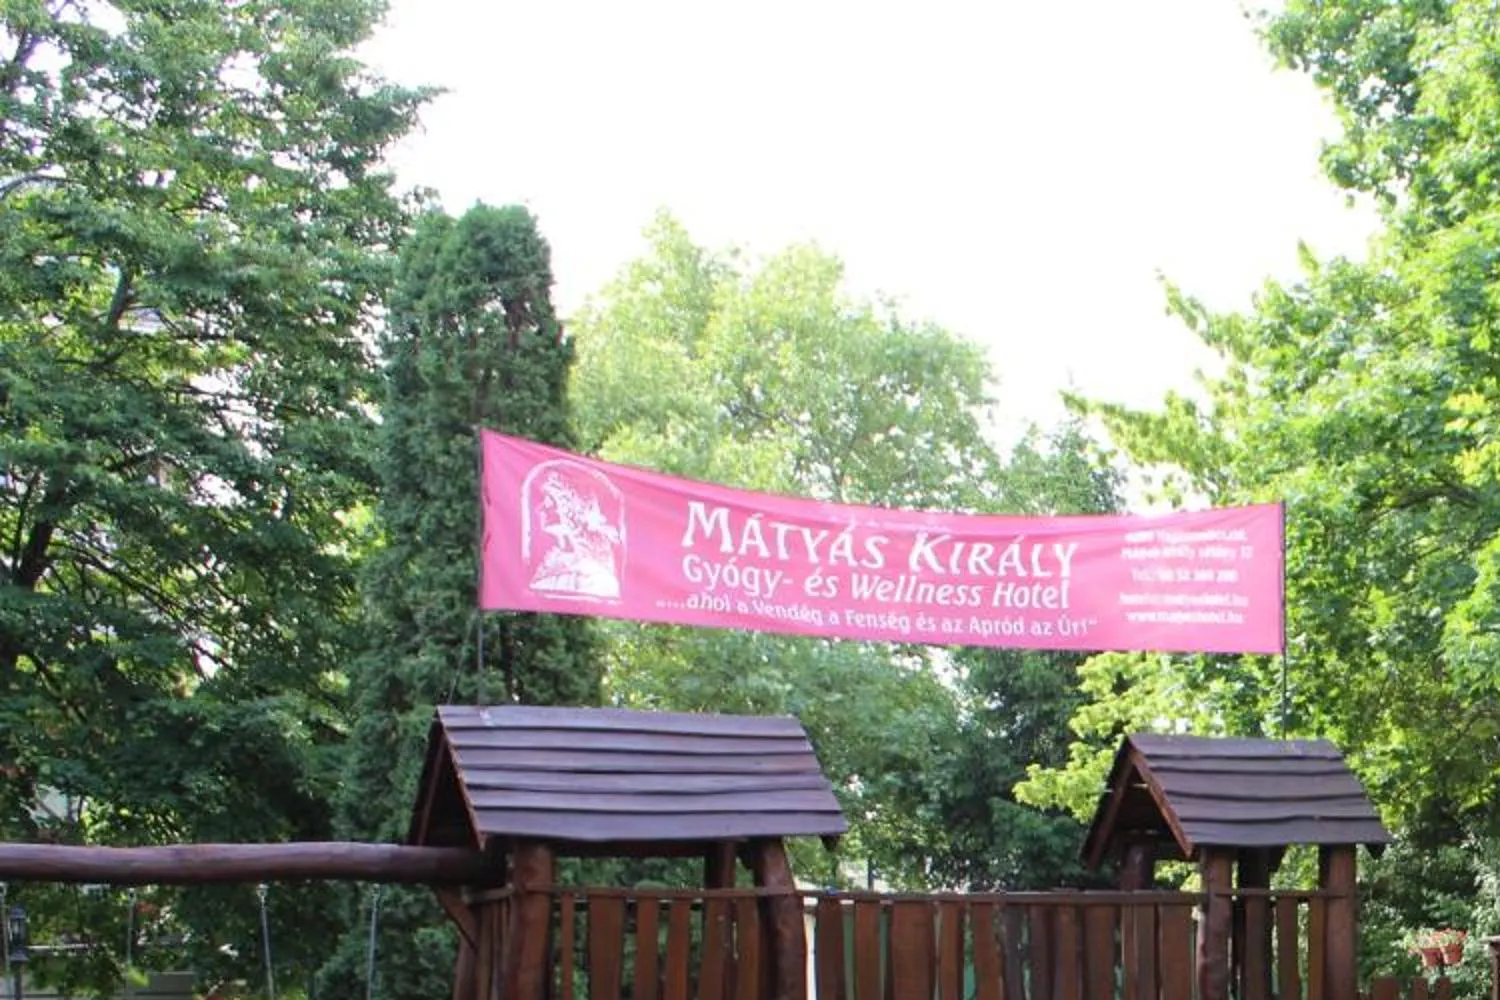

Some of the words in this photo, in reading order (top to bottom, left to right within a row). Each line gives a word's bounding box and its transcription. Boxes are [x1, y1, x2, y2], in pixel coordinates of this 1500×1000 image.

[680, 500, 890, 570] MÁTYÁS
[908, 530, 1079, 578] KIRÁLY
[682, 553, 793, 600] Gyógy-
[804, 566, 840, 599] és
[851, 572, 984, 607] Wellness
[991, 579, 1071, 609] Hotel
[736, 601, 749, 615] a
[751, 599, 823, 627] Vendég
[828, 610, 840, 626] a
[846, 609, 911, 635] Fenség
[915, 611, 936, 632] és
[941, 617, 964, 634] az
[969, 615, 1025, 639] Apród
[1030, 621, 1053, 636] az
